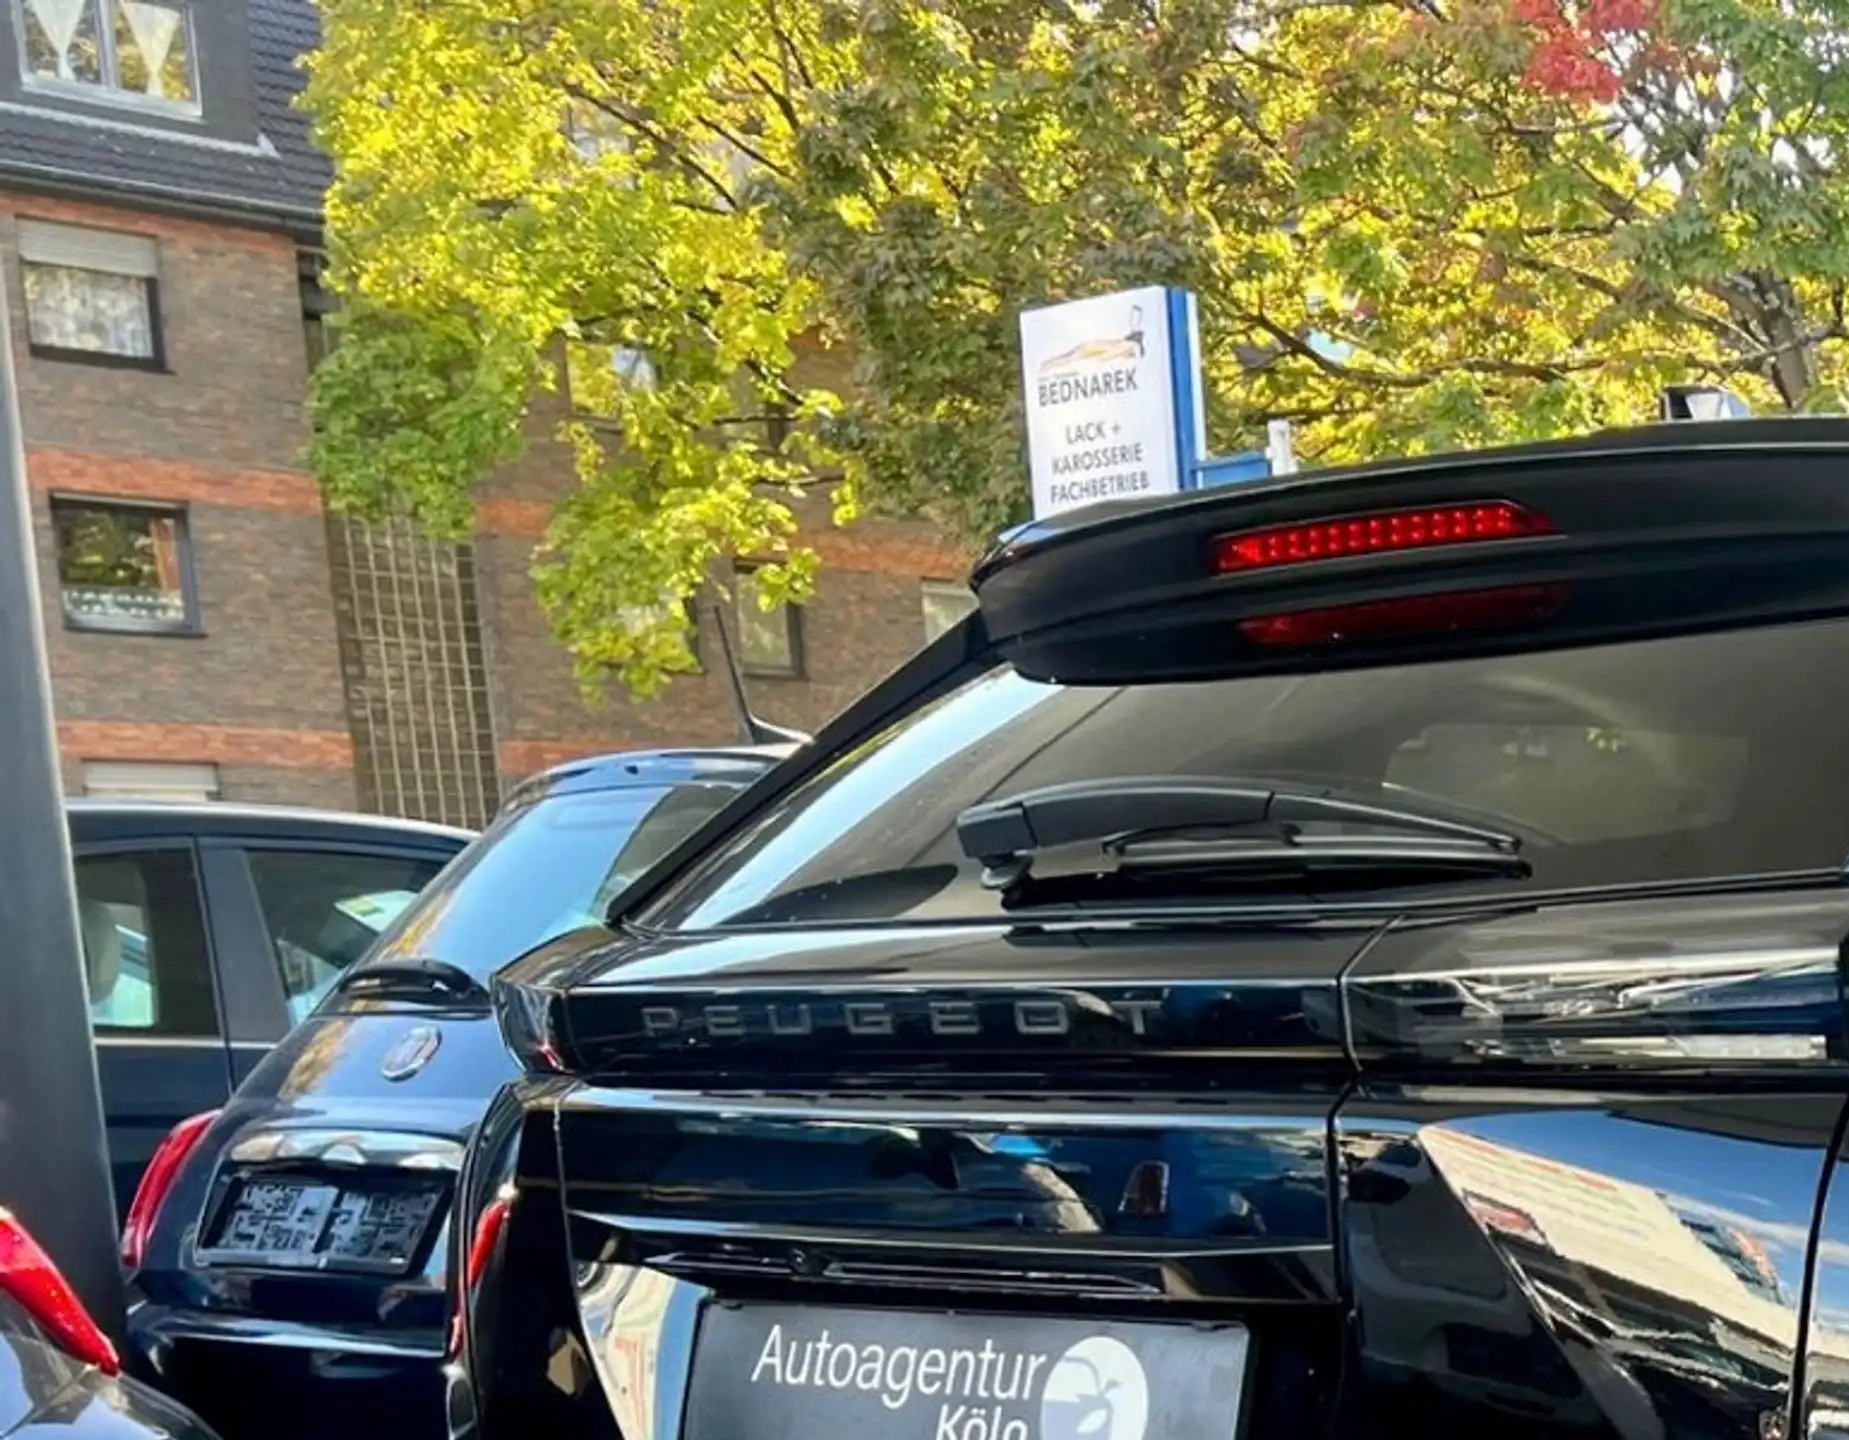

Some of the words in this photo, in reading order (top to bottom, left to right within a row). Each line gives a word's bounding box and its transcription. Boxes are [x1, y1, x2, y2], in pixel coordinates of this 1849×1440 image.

[1038, 368, 1138, 407] BEDNAREK
[1065, 421, 1106, 446] LACK
[1052, 442, 1144, 475] KAROSSERIE
[1050, 471, 1150, 505] FACHBETRIEB
[640, 1000, 1165, 1036] PEUGEOT
[750, 1324, 1047, 1410] Autoagentur
